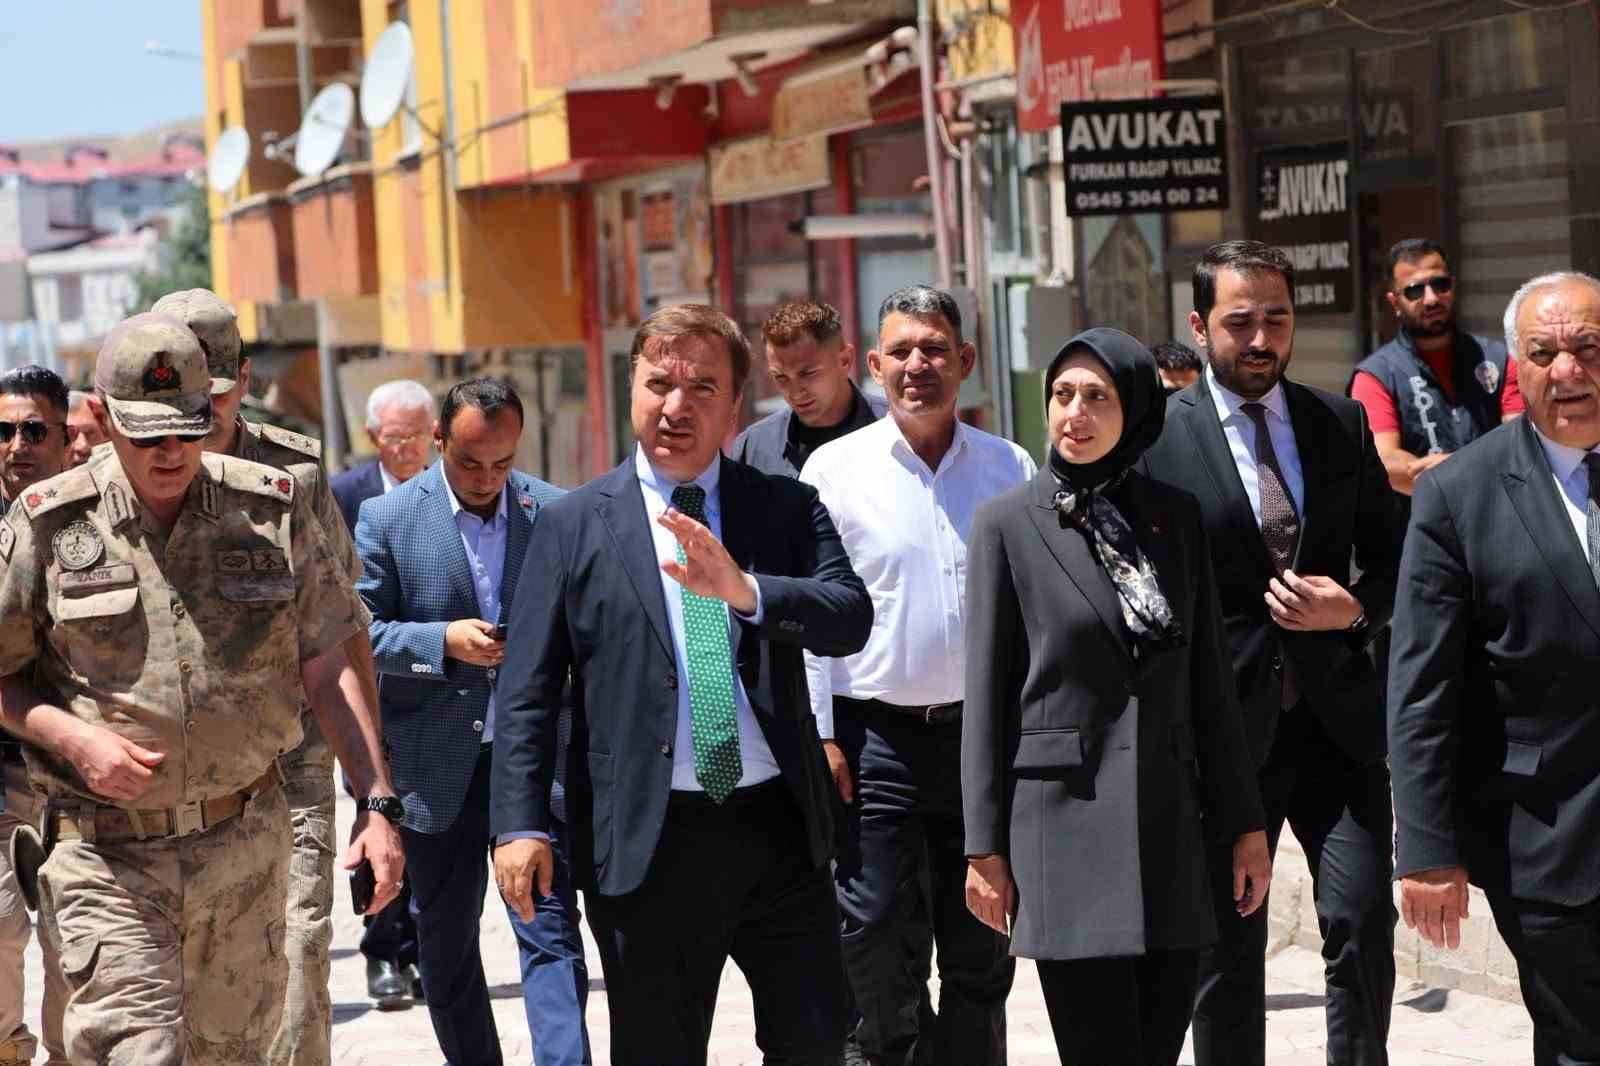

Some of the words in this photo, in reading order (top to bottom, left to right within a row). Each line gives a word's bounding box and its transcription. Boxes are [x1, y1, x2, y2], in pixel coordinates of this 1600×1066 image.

[1067, 109, 1221, 151] AVUKAT
[1070, 162, 1125, 181] FURKAN
[1171, 157, 1222, 176] YILMAZ
[1075, 190, 1122, 209] 0545
[1127, 188, 1162, 206] 304
[1166, 186, 1190, 204] 00
[1196, 185, 1218, 203] 24
[1278, 160, 1348, 216] AVUKAT
